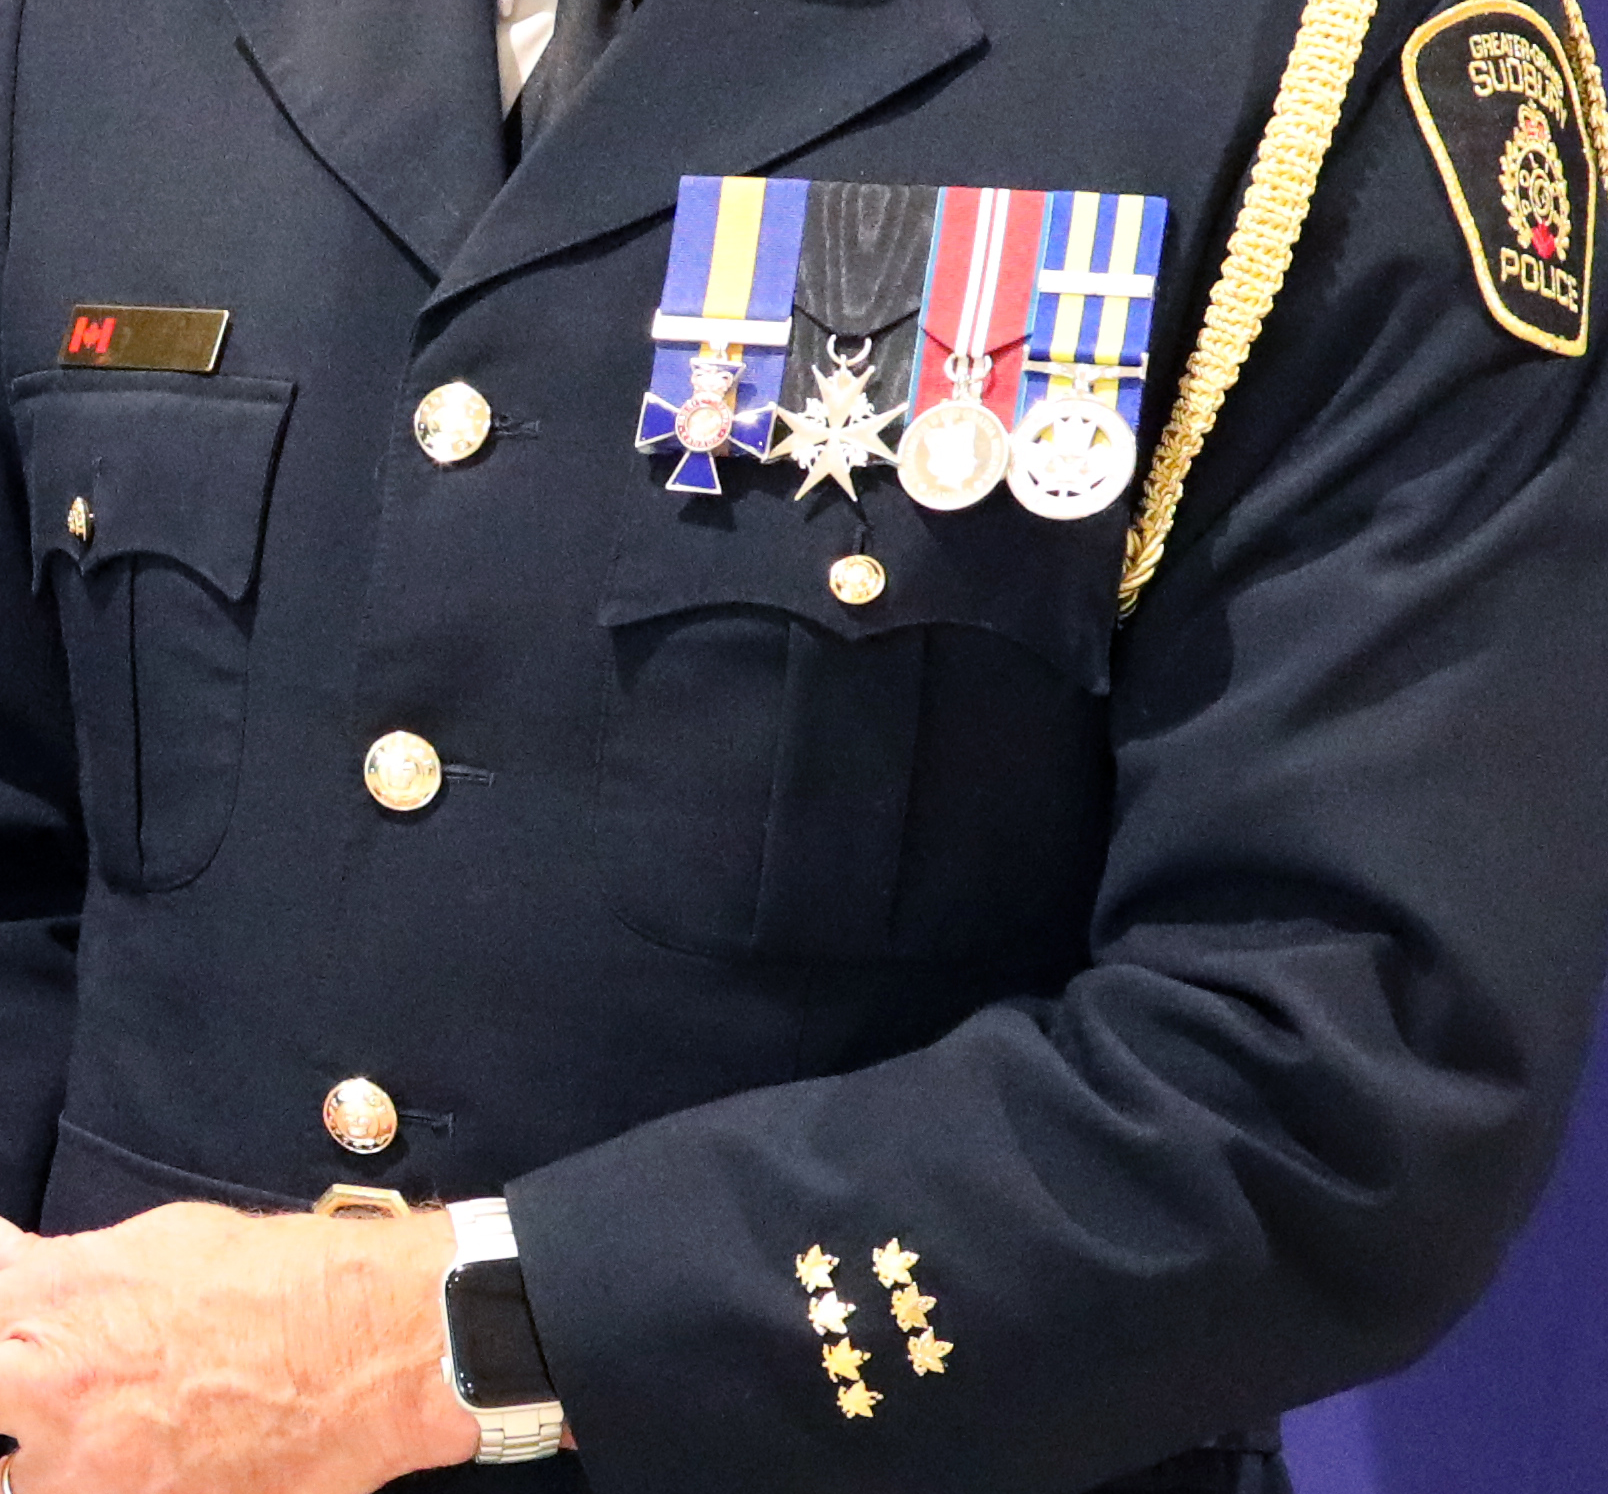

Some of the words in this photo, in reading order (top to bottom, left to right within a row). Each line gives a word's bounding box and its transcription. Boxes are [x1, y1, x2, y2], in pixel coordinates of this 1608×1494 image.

[1469, 32, 1530, 61] GREATER
[1468, 57, 1567, 129] SUDBURY
[1500, 247, 1579, 313] POLICE
